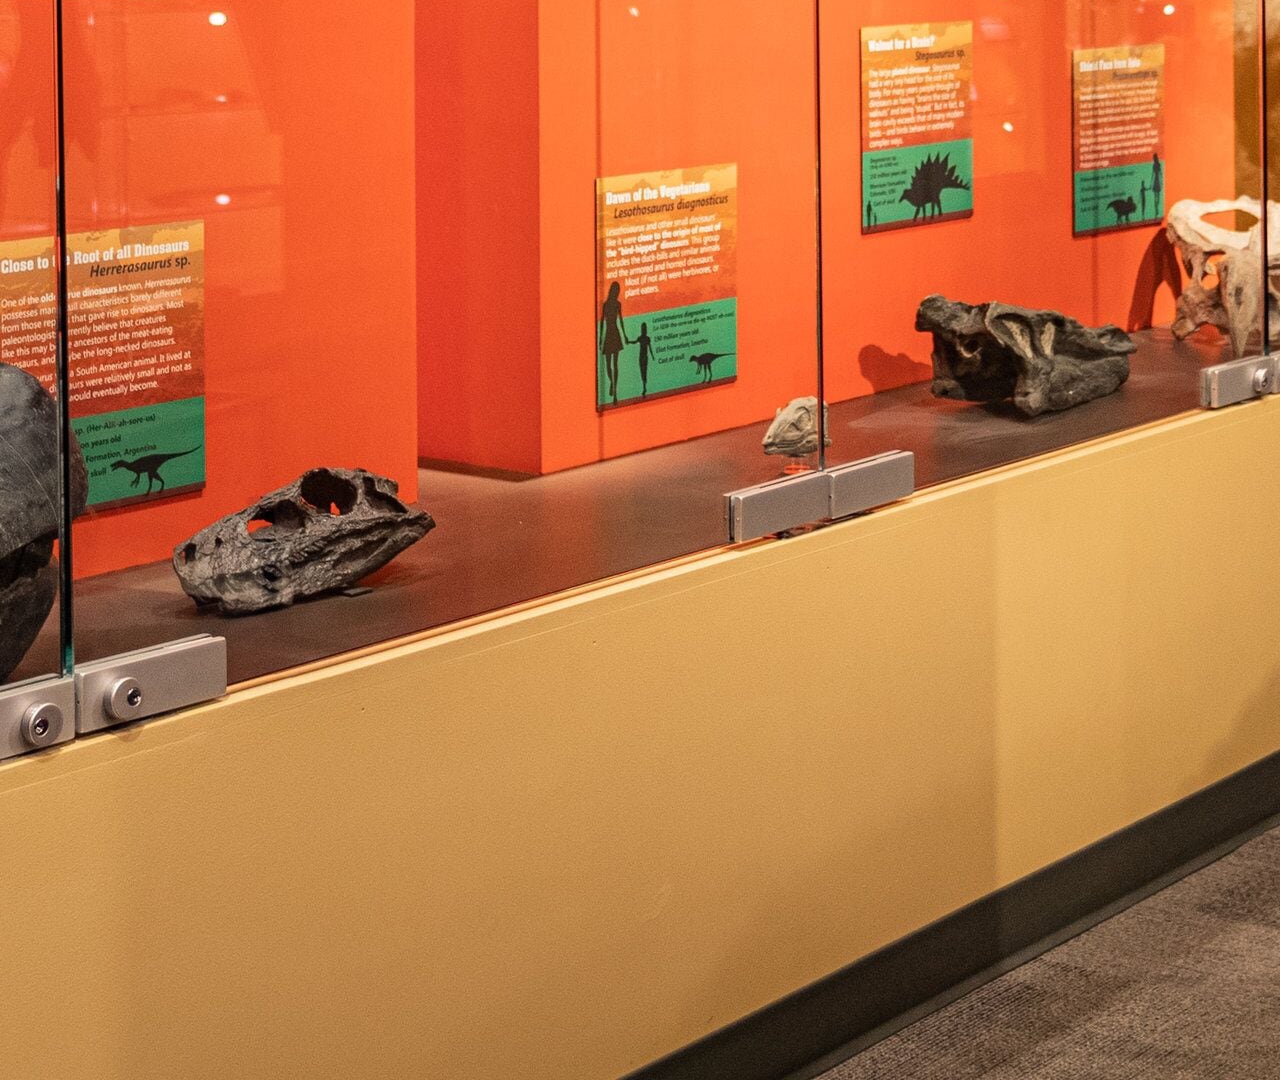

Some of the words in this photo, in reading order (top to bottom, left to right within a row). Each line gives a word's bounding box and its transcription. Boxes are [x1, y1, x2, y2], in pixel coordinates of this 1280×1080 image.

[606, 192, 632, 206] Dawn
[633, 188, 642, 202] of
[644, 187, 658, 201] the
[613, 203, 674, 219] Lesothosaurus
[677, 195, 729, 211] diagnosticus
[1, 260, 34, 274] Close
[37, 255, 54, 269] to
[74, 250, 101, 265] Root
[103, 247, 114, 262] of
[117, 245, 132, 260] all
[134, 241, 190, 257] Dinosaurs
[90, 259, 172, 278] Herrerasaurus
[175, 256, 191, 268] sp.
[85, 378, 103, 387] were
[104, 372, 136, 384] relatively
[137, 368, 155, 379] small
[156, 366, 170, 375] and
[171, 364, 183, 373] not
[184, 363, 192, 371] as
[91, 439, 109, 449] years
[110, 434, 121, 442] old
